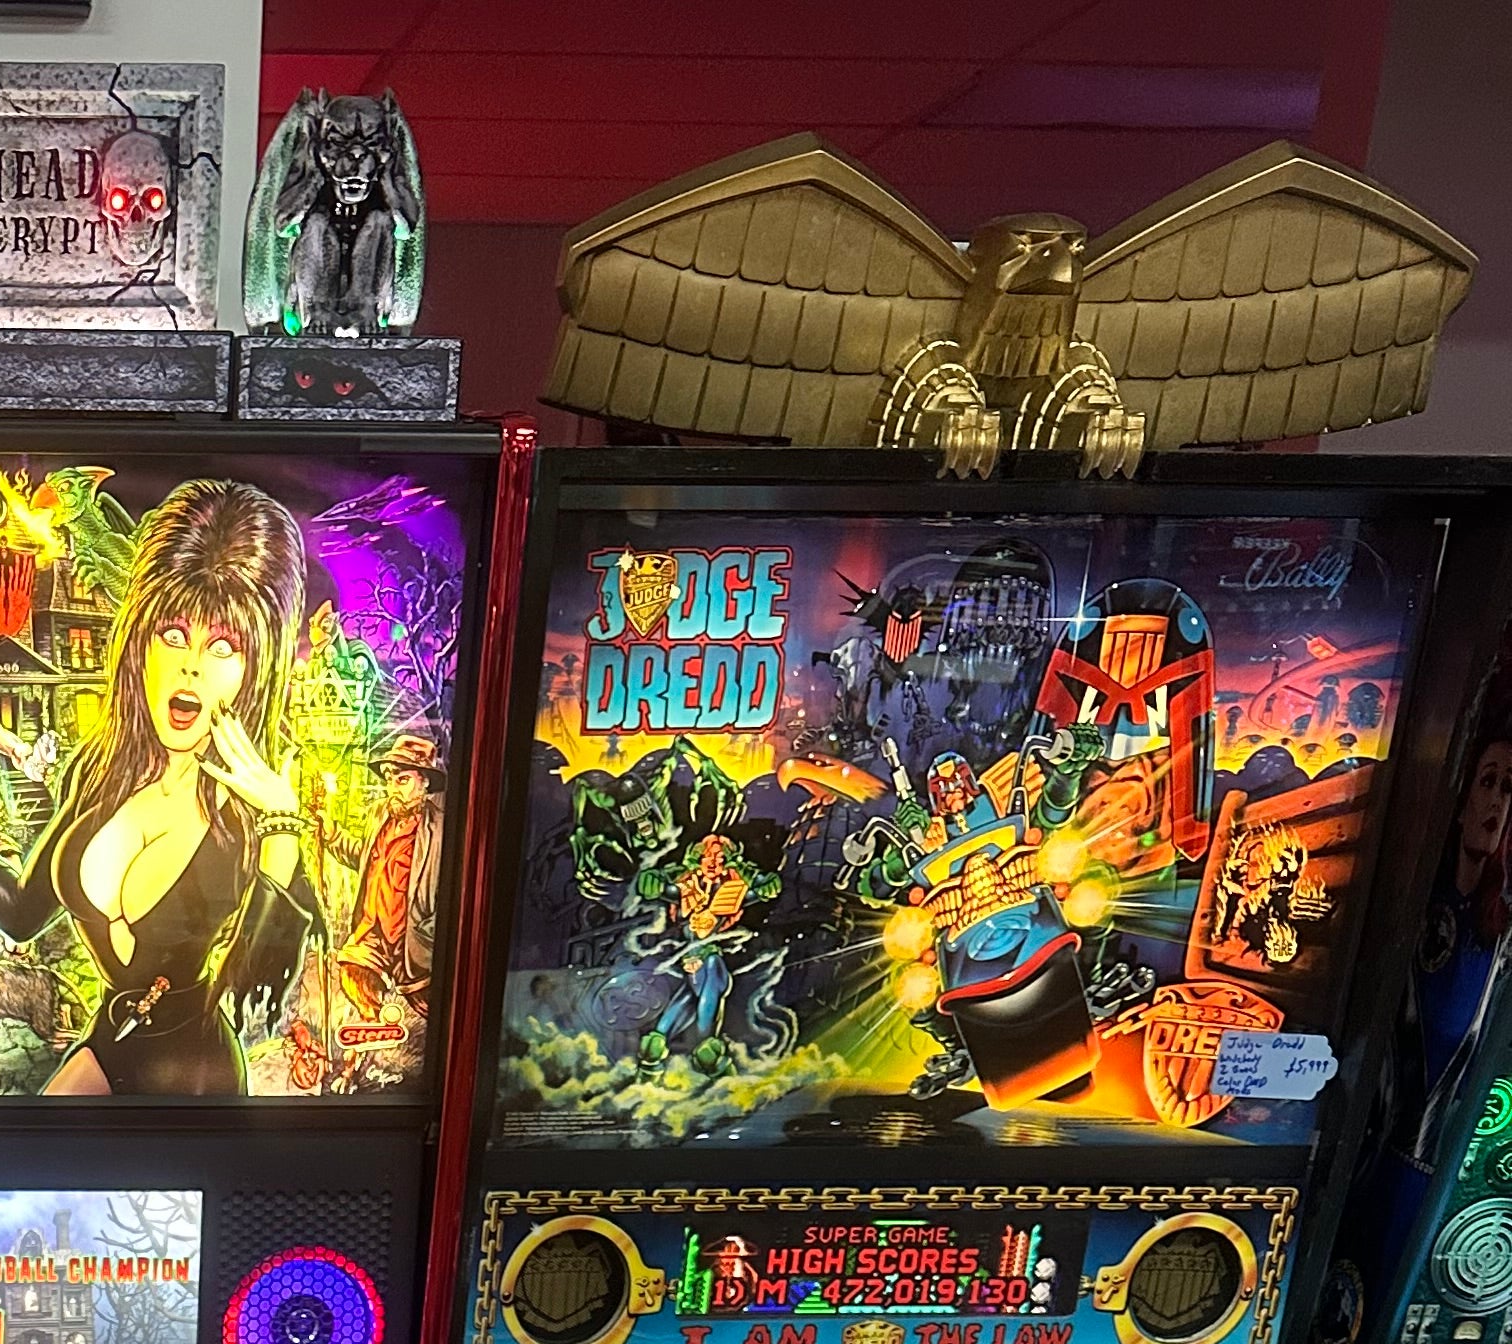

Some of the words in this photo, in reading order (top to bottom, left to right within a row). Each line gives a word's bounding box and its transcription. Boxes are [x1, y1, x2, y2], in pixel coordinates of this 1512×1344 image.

[588, 550, 788, 641] JDGE
[586, 643, 781, 730] DREDD
[1284, 1057, 1329, 1078] $5,999
[804, 1227, 877, 1244] SUPER
[888, 1227, 949, 1244] GAME
[67, 1256, 191, 1284] CHAMPION
[767, 1248, 846, 1274] HIGH
[857, 1248, 980, 1274] SCORES
